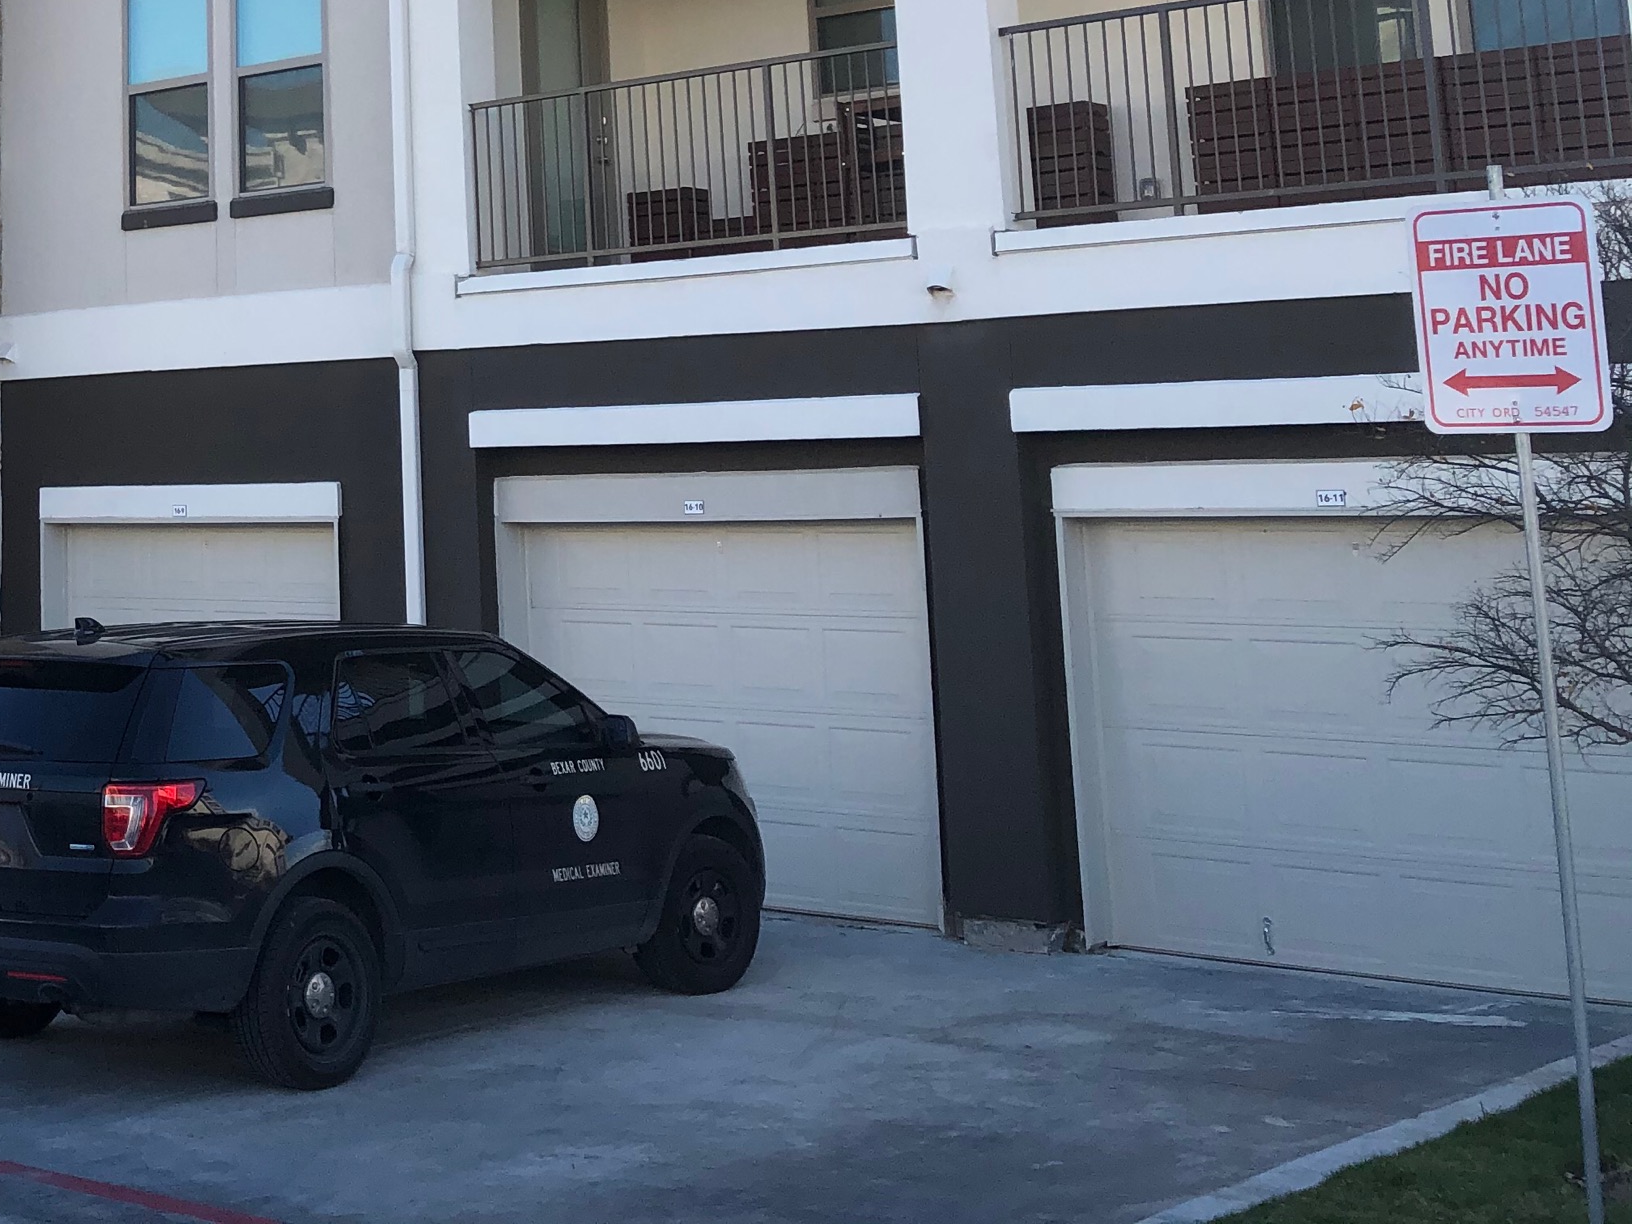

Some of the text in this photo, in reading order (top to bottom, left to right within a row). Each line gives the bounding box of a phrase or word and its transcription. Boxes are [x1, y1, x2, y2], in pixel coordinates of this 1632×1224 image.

[1428, 236, 1572, 267] FIRE LANE
[1479, 272, 1529, 301] NO
[1430, 302, 1587, 335] PARKING
[1454, 337, 1568, 360] ANYTIME
[1456, 407, 1485, 418] CITY
[1534, 406, 1579, 417] 54547
[684, 503, 704, 511] 16-10
[1318, 493, 1344, 503] 16-11
[550, 758, 605, 775] BEXAR COUNTY
[638, 750, 667, 772] 6601
[552, 861, 621, 882] MEDICAL EXAMINER
